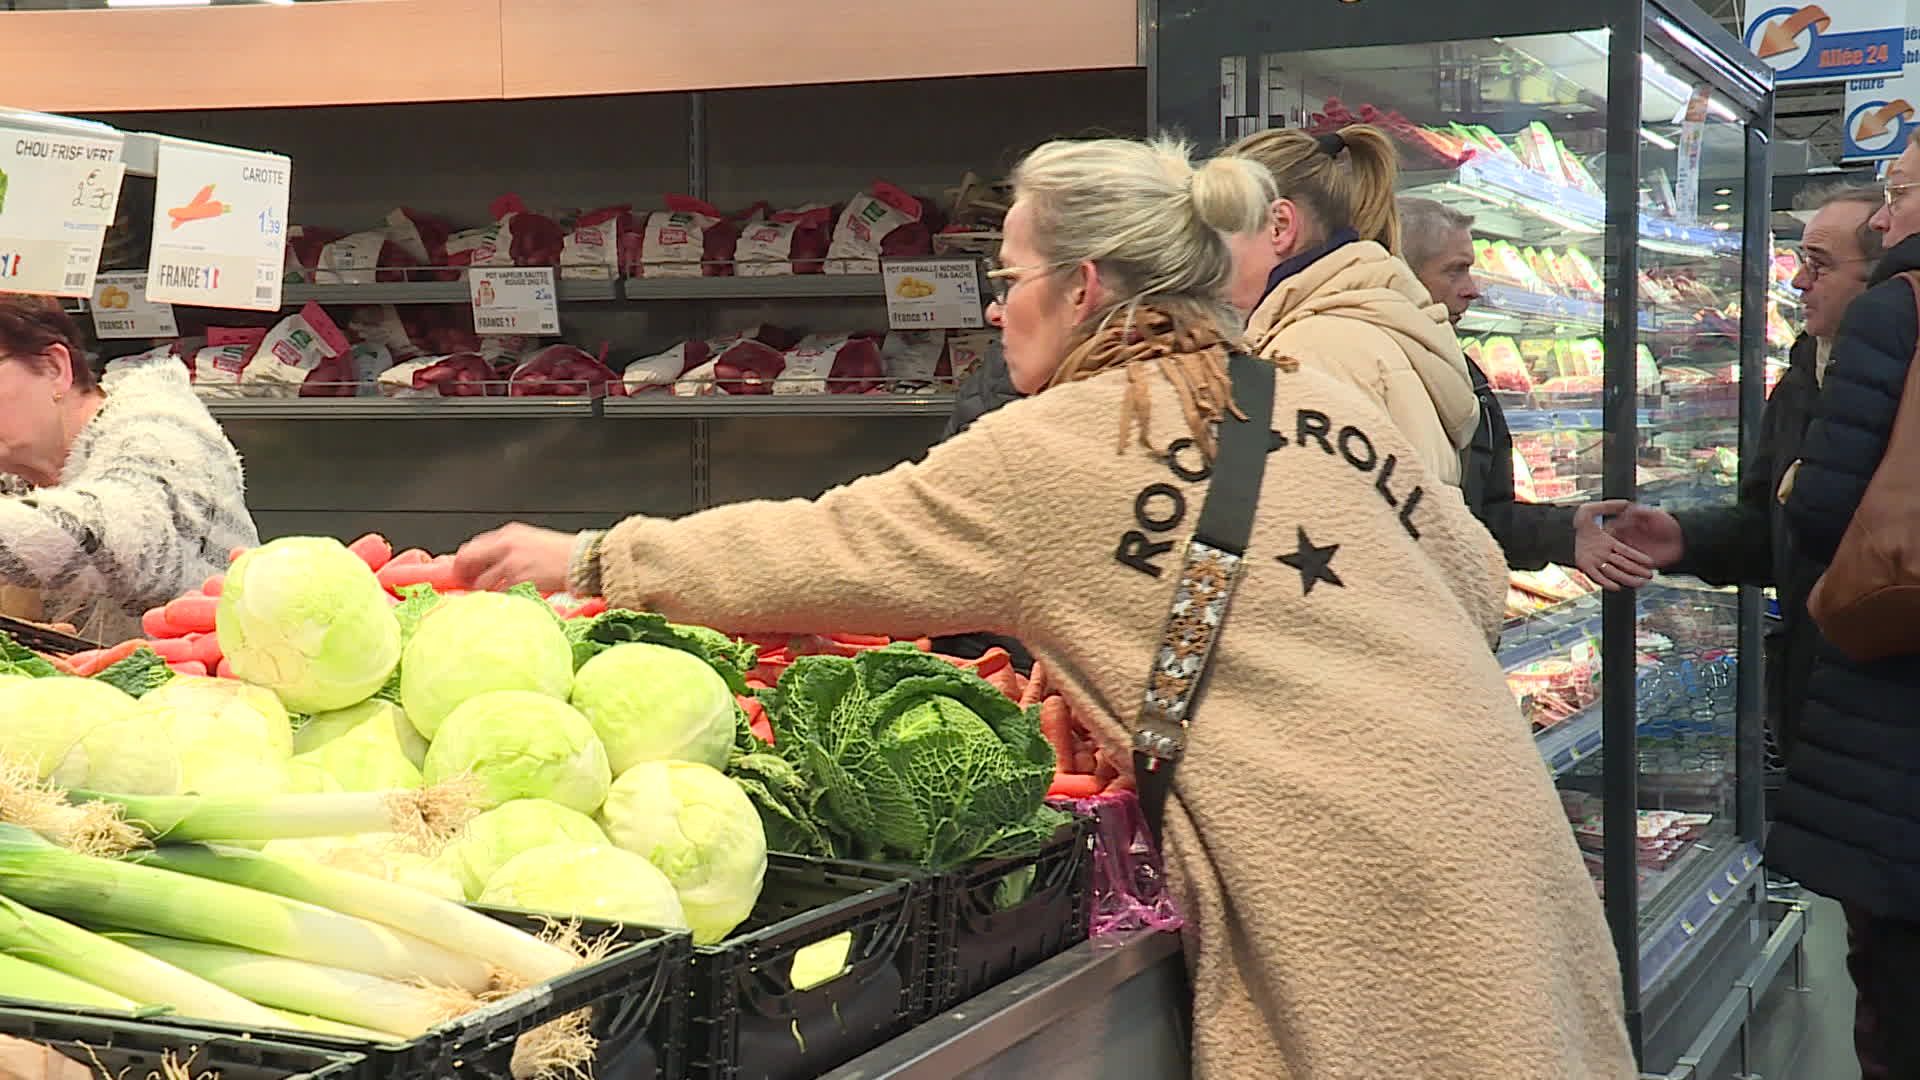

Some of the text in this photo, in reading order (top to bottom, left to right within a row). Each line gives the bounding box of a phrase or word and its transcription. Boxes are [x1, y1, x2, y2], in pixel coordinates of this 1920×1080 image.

[1818, 43, 1889, 69] Allée 24
[15, 139, 49, 158] CHOU
[242, 167, 285, 185] CAROTTE
[160, 264, 201, 289] FRANCE
[1296, 408, 1425, 540] ROLL
